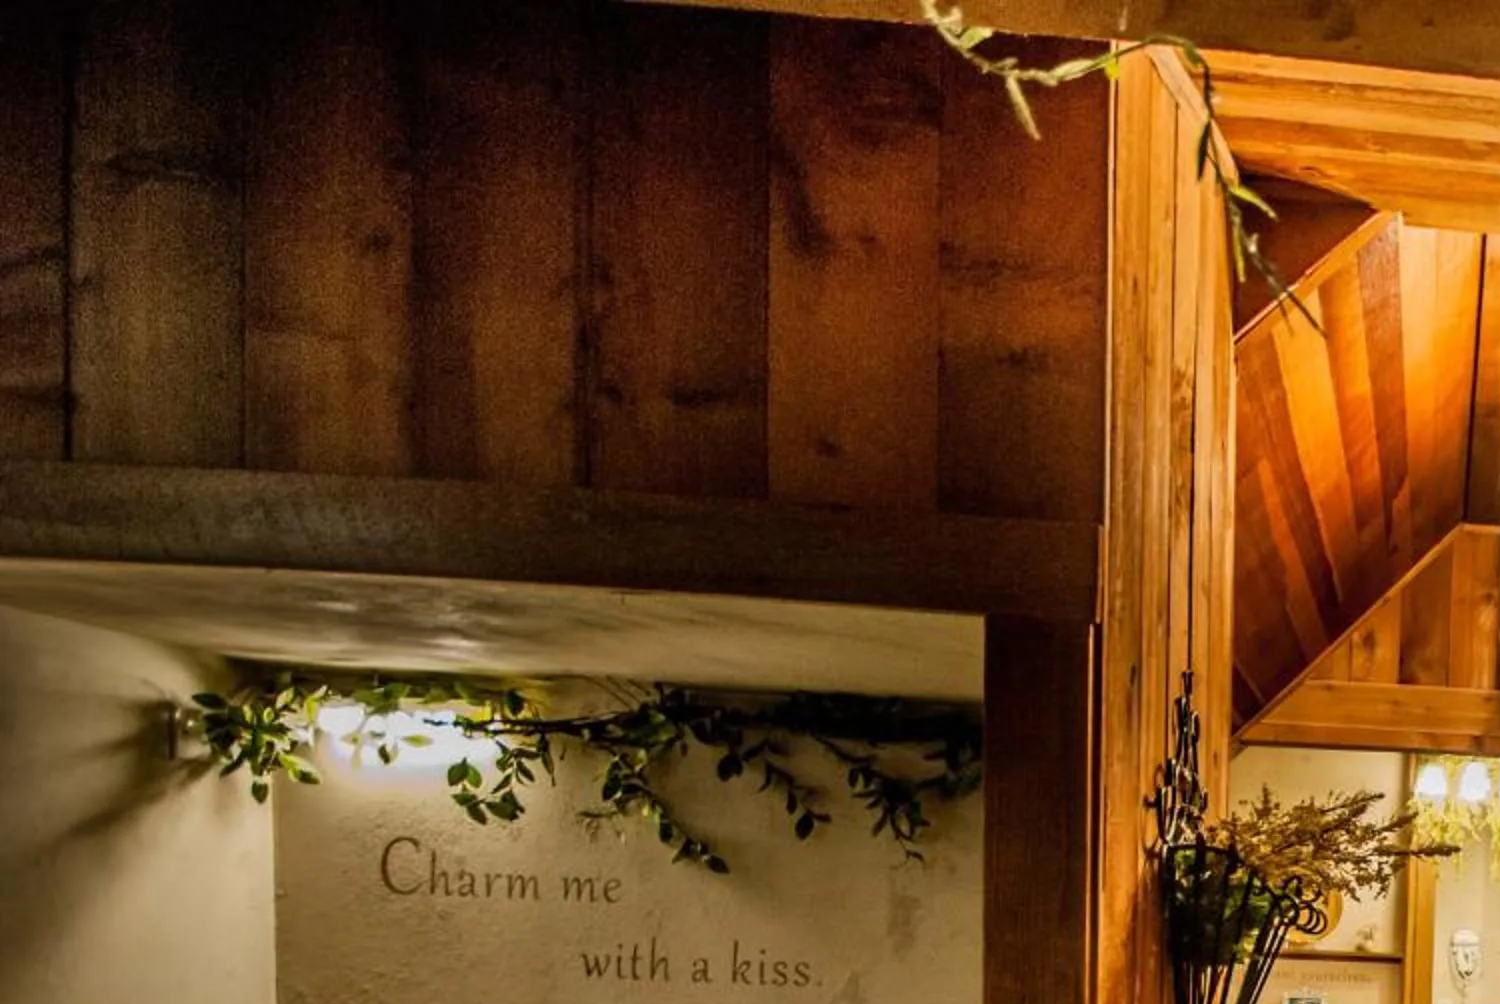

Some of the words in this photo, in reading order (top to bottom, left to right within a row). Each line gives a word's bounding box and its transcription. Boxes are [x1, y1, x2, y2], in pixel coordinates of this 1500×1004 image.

[380, 836, 540, 900] Charm
[562, 872, 622, 903] me
[581, 936, 670, 983] with
[691, 956, 713, 986] a
[731, 940, 823, 988] kiss.
